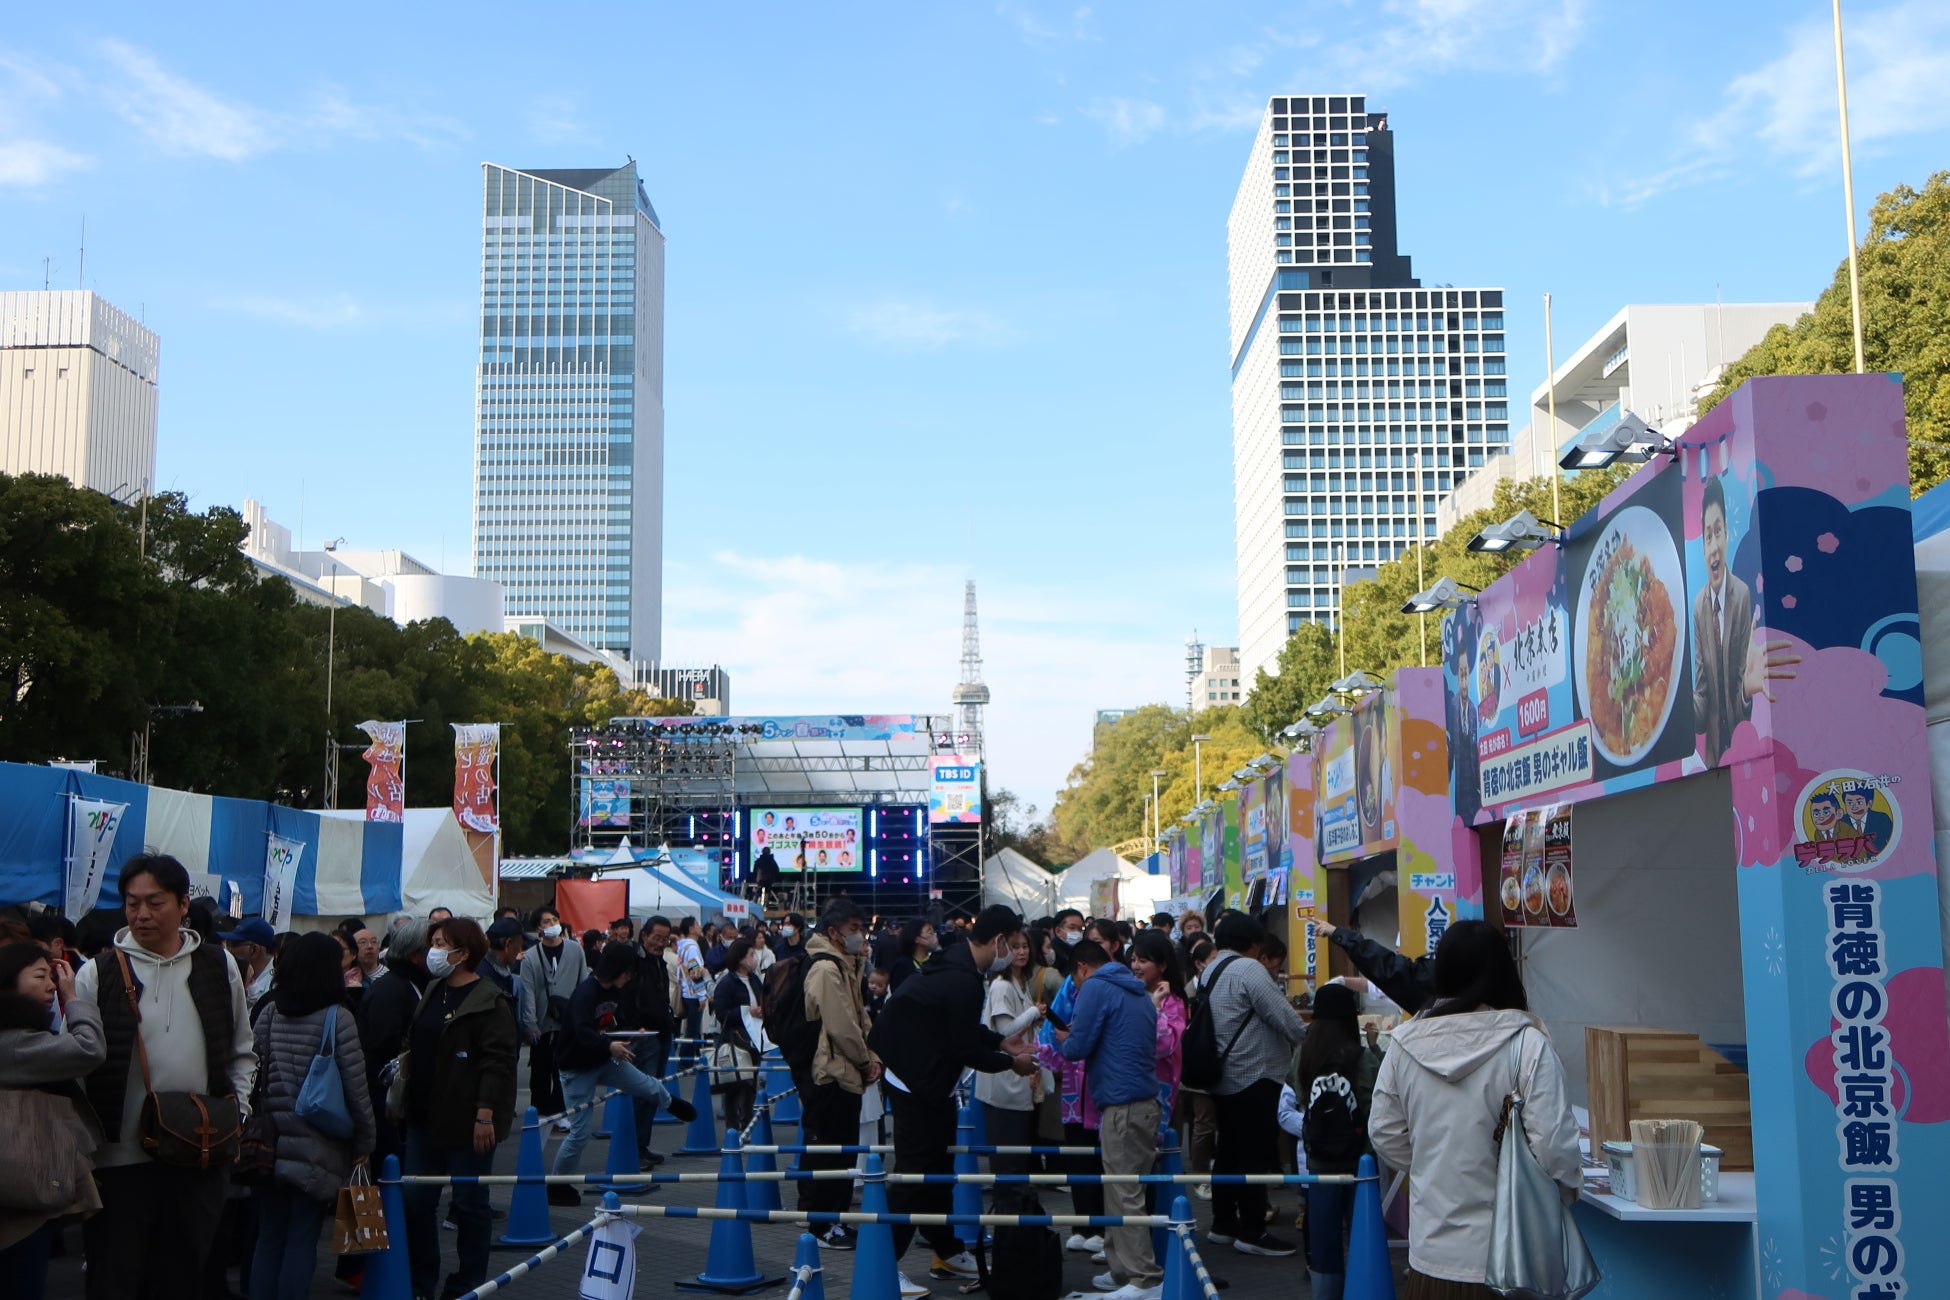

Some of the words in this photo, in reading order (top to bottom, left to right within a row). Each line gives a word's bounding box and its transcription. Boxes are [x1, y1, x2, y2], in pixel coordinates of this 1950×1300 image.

[1520, 698, 1547, 728] 1600円
[939, 769, 958, 779] TBS
[960, 769, 972, 779] ID
[1483, 754, 1531, 797] 背徳の北京飯
[1534, 736, 1588, 784] 男のギャル飯
[1794, 833, 1880, 867] デララバ
[1829, 884, 1892, 1166] 背徳の北京飯
